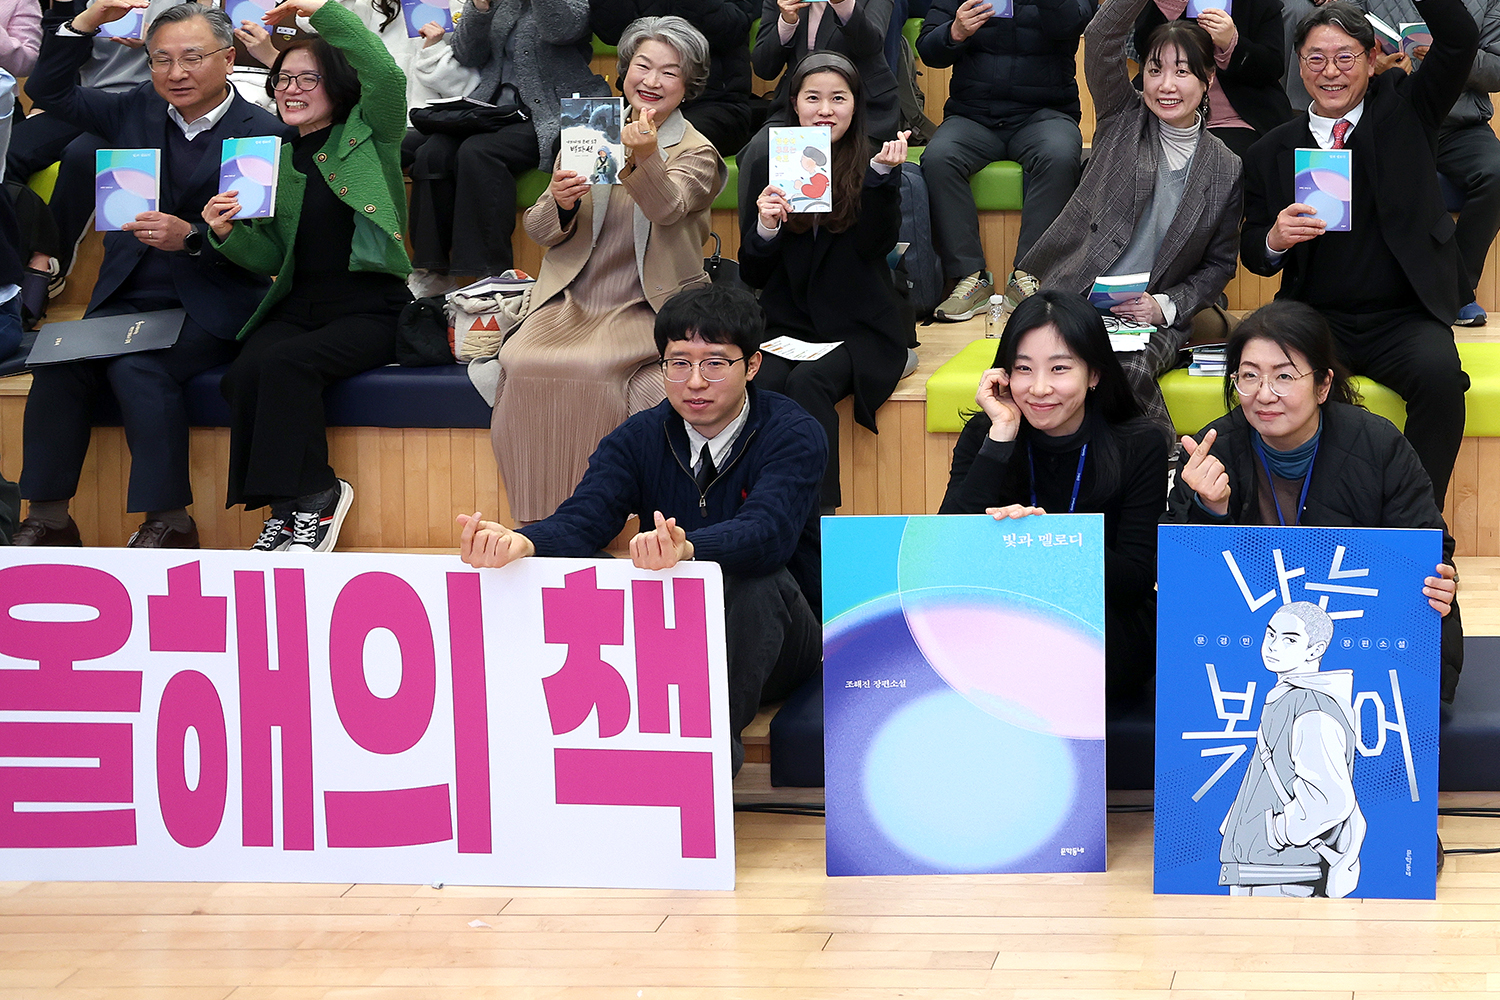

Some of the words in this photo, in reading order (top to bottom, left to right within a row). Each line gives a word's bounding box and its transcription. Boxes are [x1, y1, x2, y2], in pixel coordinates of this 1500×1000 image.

[1003, 532, 1034, 549] 빛과
[1039, 532, 1084, 548] 멜로디
[1222, 545, 1379, 620] 나는
[1341, 637, 1407, 650] 장편소설
[845, 680, 871, 690] 조해진
[873, 679, 907, 689] 장편소설
[0, 560, 492, 854] 올해의
[541, 566, 717, 859] 책
[1059, 846, 1085, 856] 문학동네
